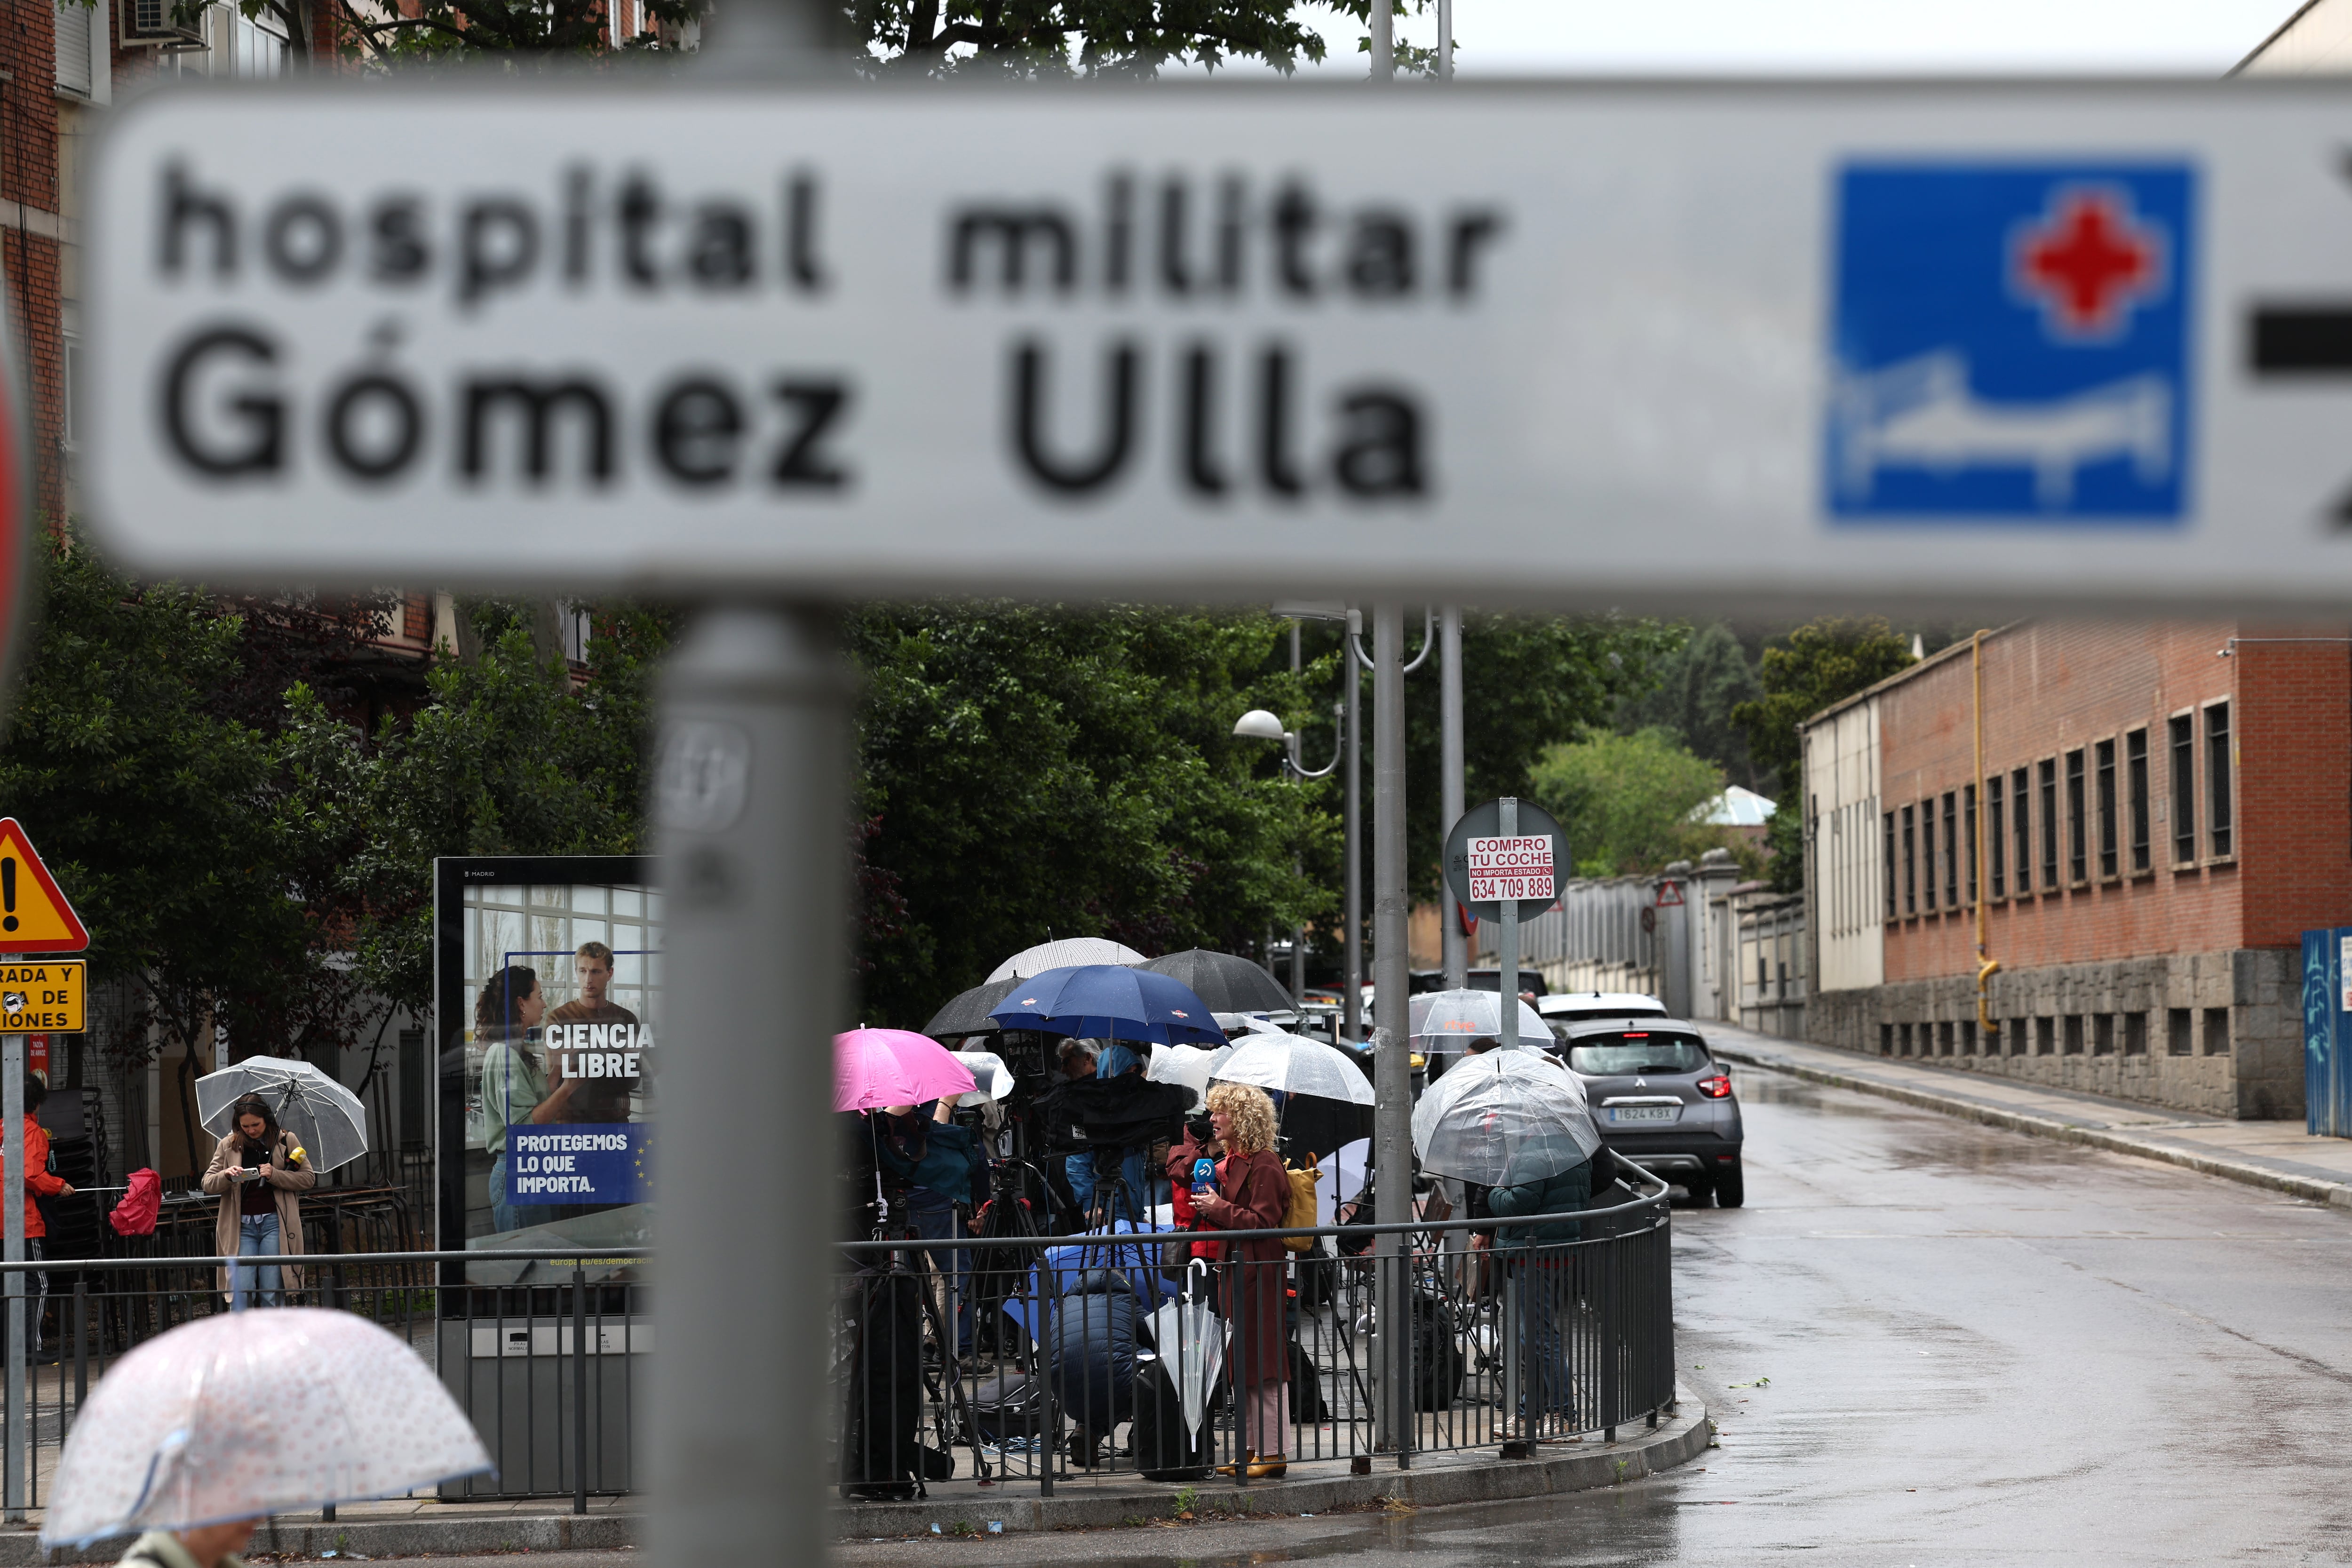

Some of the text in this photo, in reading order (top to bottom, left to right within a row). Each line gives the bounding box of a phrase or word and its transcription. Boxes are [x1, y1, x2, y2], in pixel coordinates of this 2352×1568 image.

[153, 162, 1509, 315] hospital militar
[151, 316, 1441, 514] Gómez Ulla
[1476, 838, 1546, 852] COMPRO
[1470, 854, 1490, 866] TU
[1496, 852, 1552, 866] COCHE
[1472, 877, 1552, 899] 634 709 889
[61, 968, 72, 981] Y
[43, 990, 68, 1004] DE
[3, 1013, 67, 1027] IONES
[1445, 1020, 1476, 1032] rtve
[546, 1023, 655, 1050] CIENCIA
[562, 1052, 640, 1078] LIBRE
[1649, 1108, 1671, 1118] KBX
[517, 1134, 628, 1152] PROTEGEMOS
[517, 1156, 575, 1174] LO QUE
[517, 1177, 595, 1193] IMPORTA.
